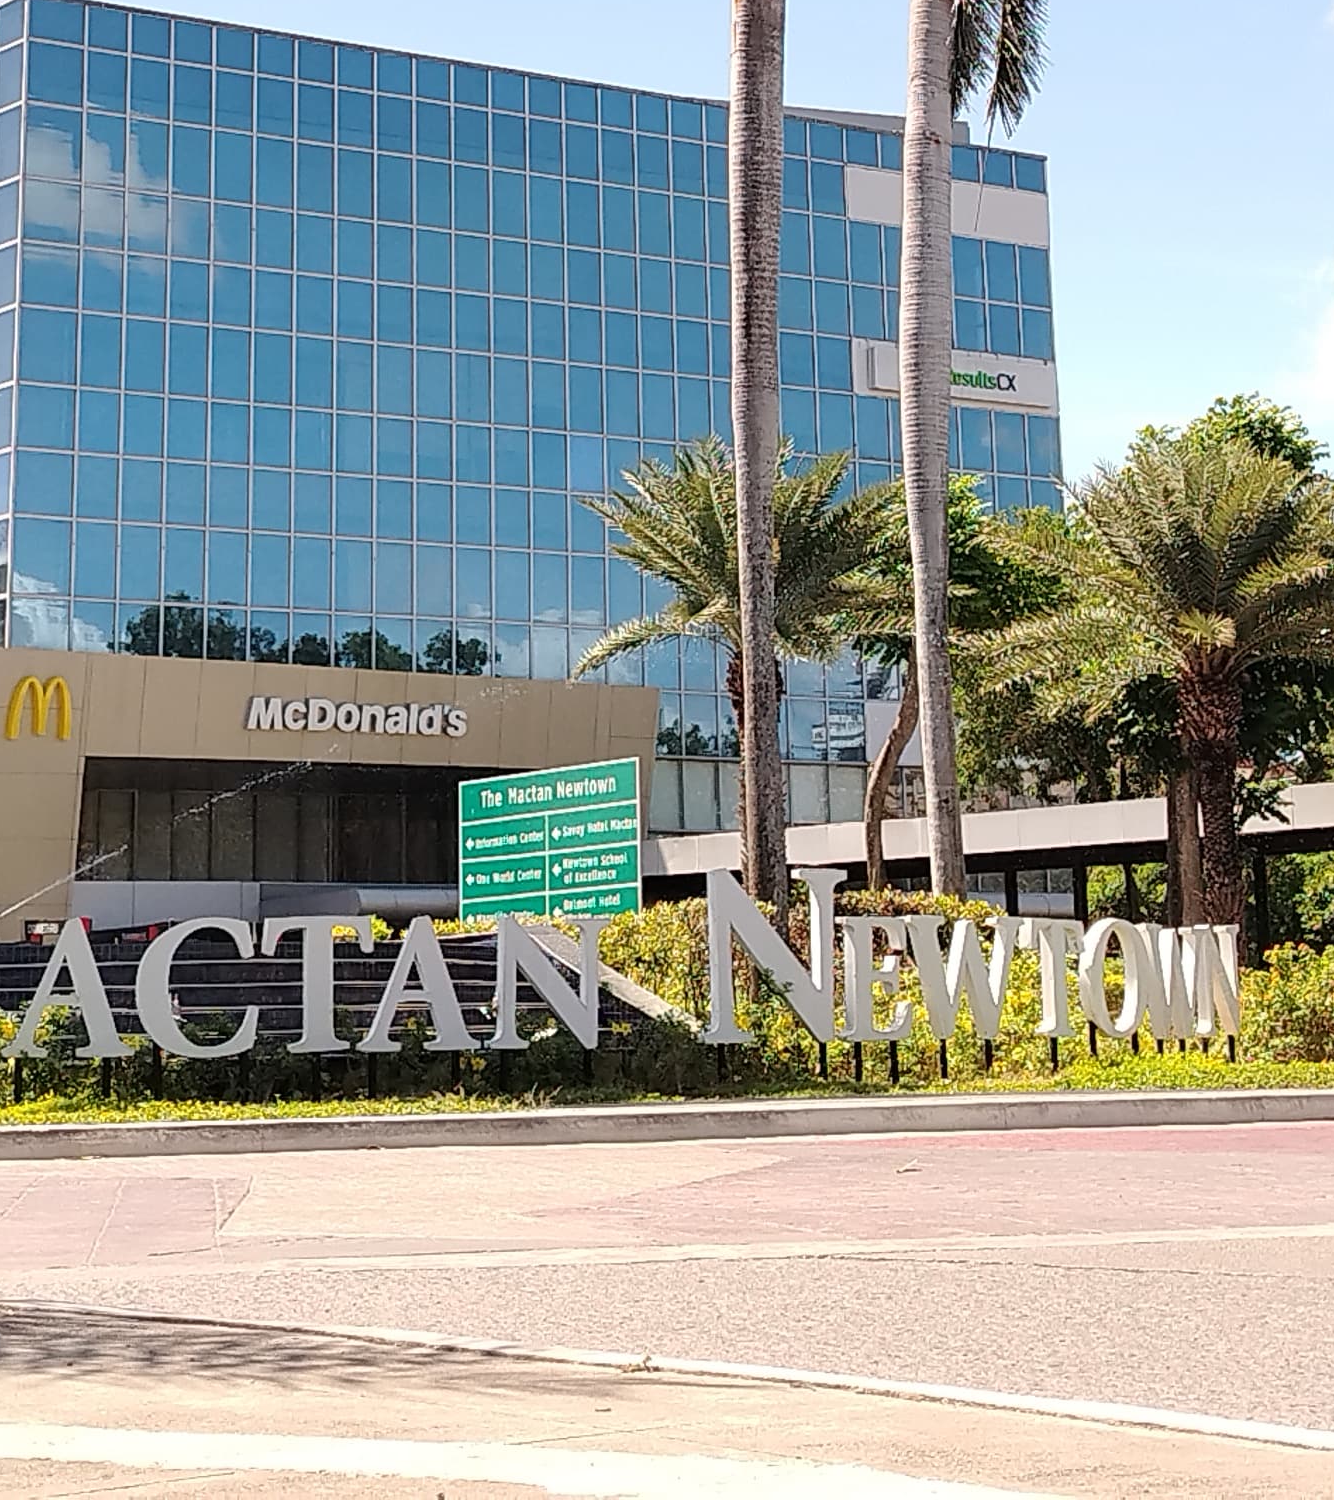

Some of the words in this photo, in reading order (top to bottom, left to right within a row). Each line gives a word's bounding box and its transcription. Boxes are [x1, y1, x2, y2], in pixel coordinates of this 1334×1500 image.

[246, 696, 468, 738] McDonald's
[480, 790, 503, 809] The
[507, 784, 553, 805] Mactan
[556, 776, 617, 799] Newtown
[519, 831, 544, 844] Center
[562, 825, 585, 838] Savoy
[587, 820, 609, 834] Hotel
[562, 856, 598, 869] Newtown
[600, 852, 628, 867] School
[476, 873, 490, 885] One
[492, 870, 515, 883] World
[517, 869, 542, 882] Center
[563, 871, 573, 884] of
[574, 869, 617, 883] Excellence
[598, 892, 621, 908] Hotel
[702, 867, 1244, 1045] NEWTOWN
